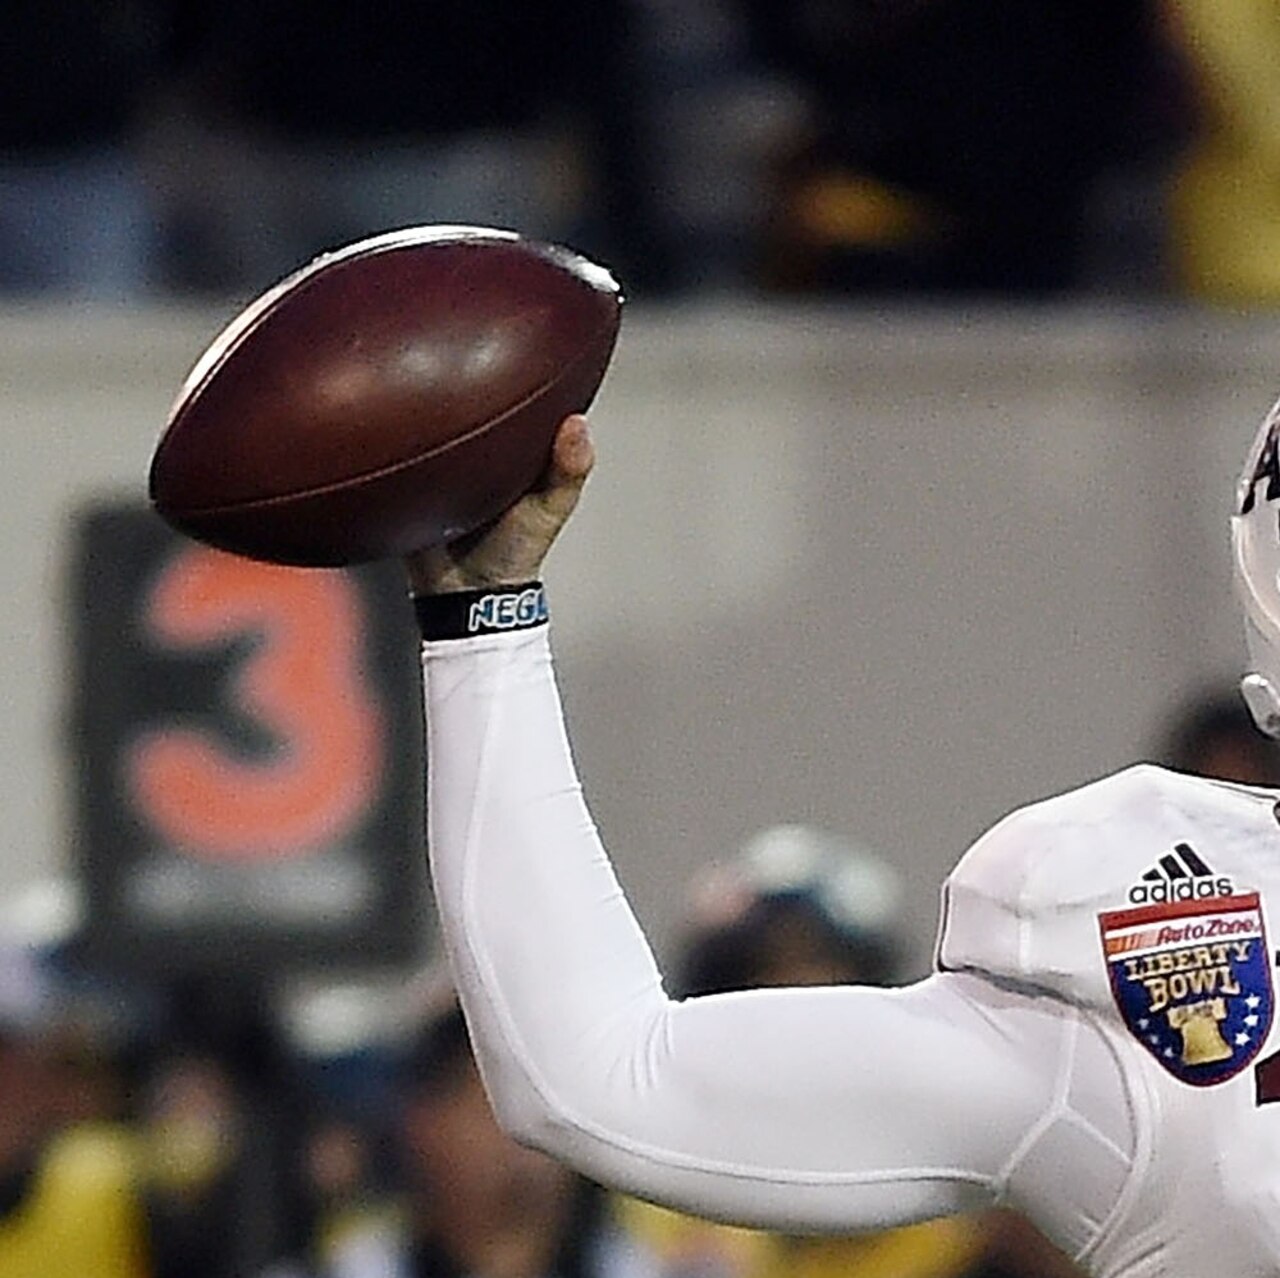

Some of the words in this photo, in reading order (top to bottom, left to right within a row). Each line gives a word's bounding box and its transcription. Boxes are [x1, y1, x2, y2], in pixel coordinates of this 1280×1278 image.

[128, 540, 384, 860] 3
[1129, 877, 1233, 904] adidas
[1124, 941, 1250, 981] LIBERTY
[1143, 965, 1240, 1012] BOWL
